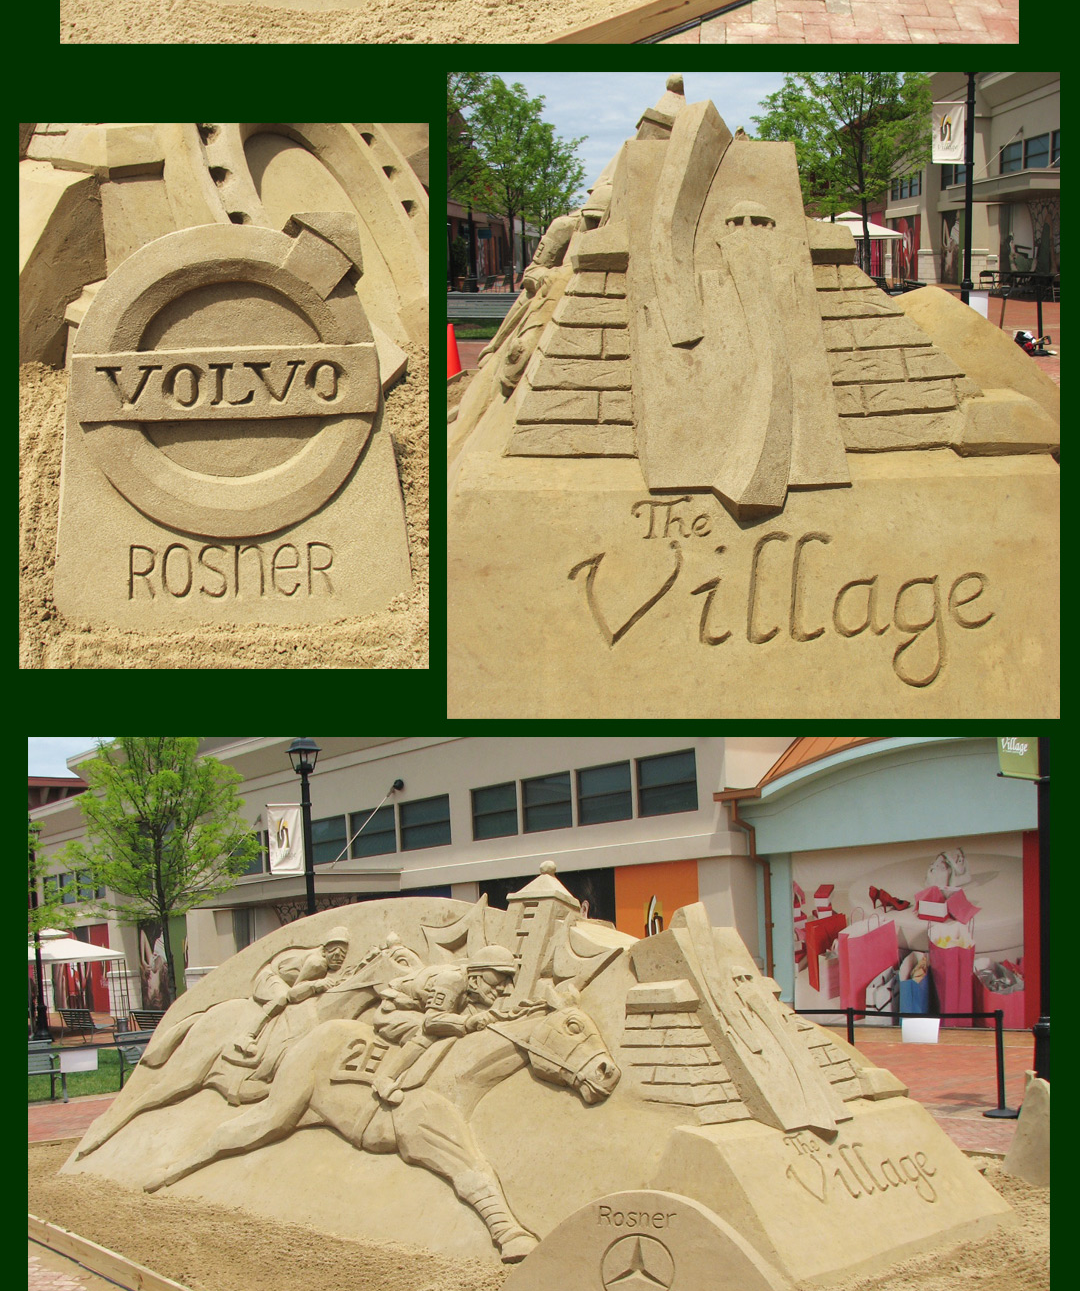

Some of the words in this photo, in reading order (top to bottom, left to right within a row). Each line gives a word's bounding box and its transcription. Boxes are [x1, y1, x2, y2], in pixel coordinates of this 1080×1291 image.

[95, 360, 348, 410] VOLVO
[631, 496, 713, 540] The
[567, 530, 996, 688] Village
[1001, 737, 1028, 756] Village
[782, 1132, 821, 1156] The
[785, 1142, 938, 1204] Village
[597, 1205, 678, 1229] Rosner
